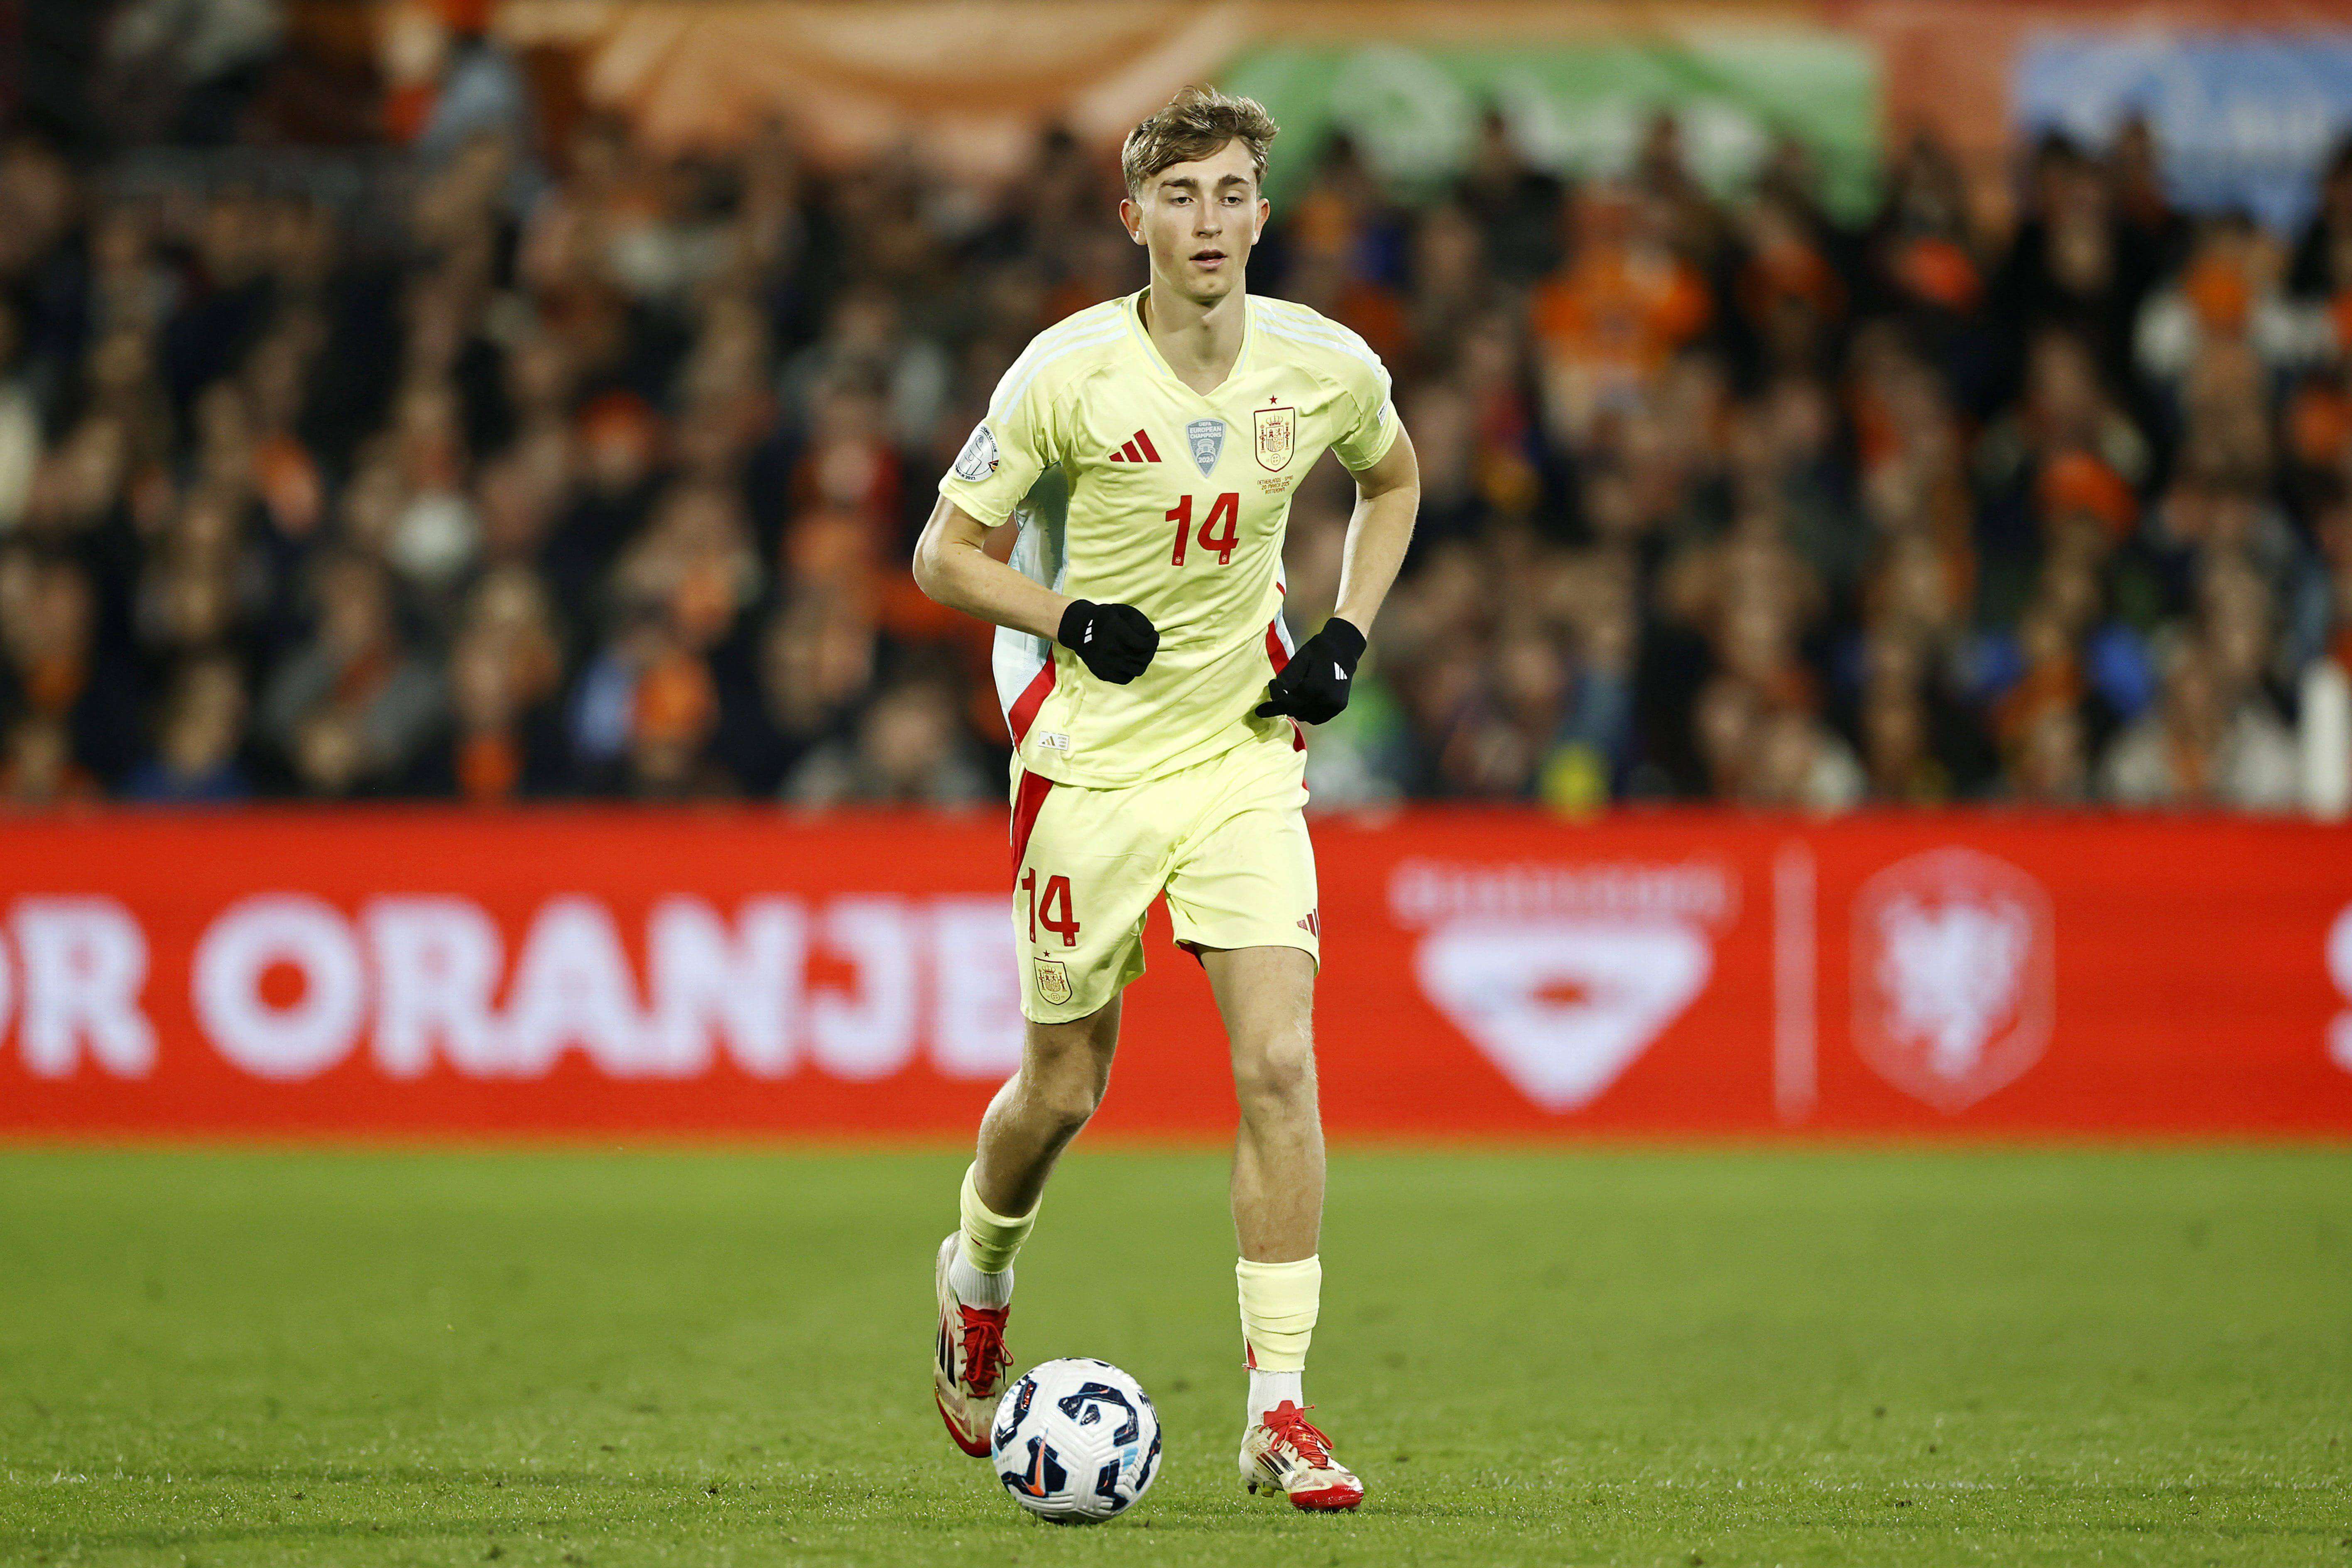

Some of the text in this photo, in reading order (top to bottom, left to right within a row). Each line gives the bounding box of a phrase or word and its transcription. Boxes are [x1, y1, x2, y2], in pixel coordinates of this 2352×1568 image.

[1166, 493, 1240, 566] 14
[1022, 867, 1080, 947] 14
[0, 892, 1019, 1081] R ORANJE
